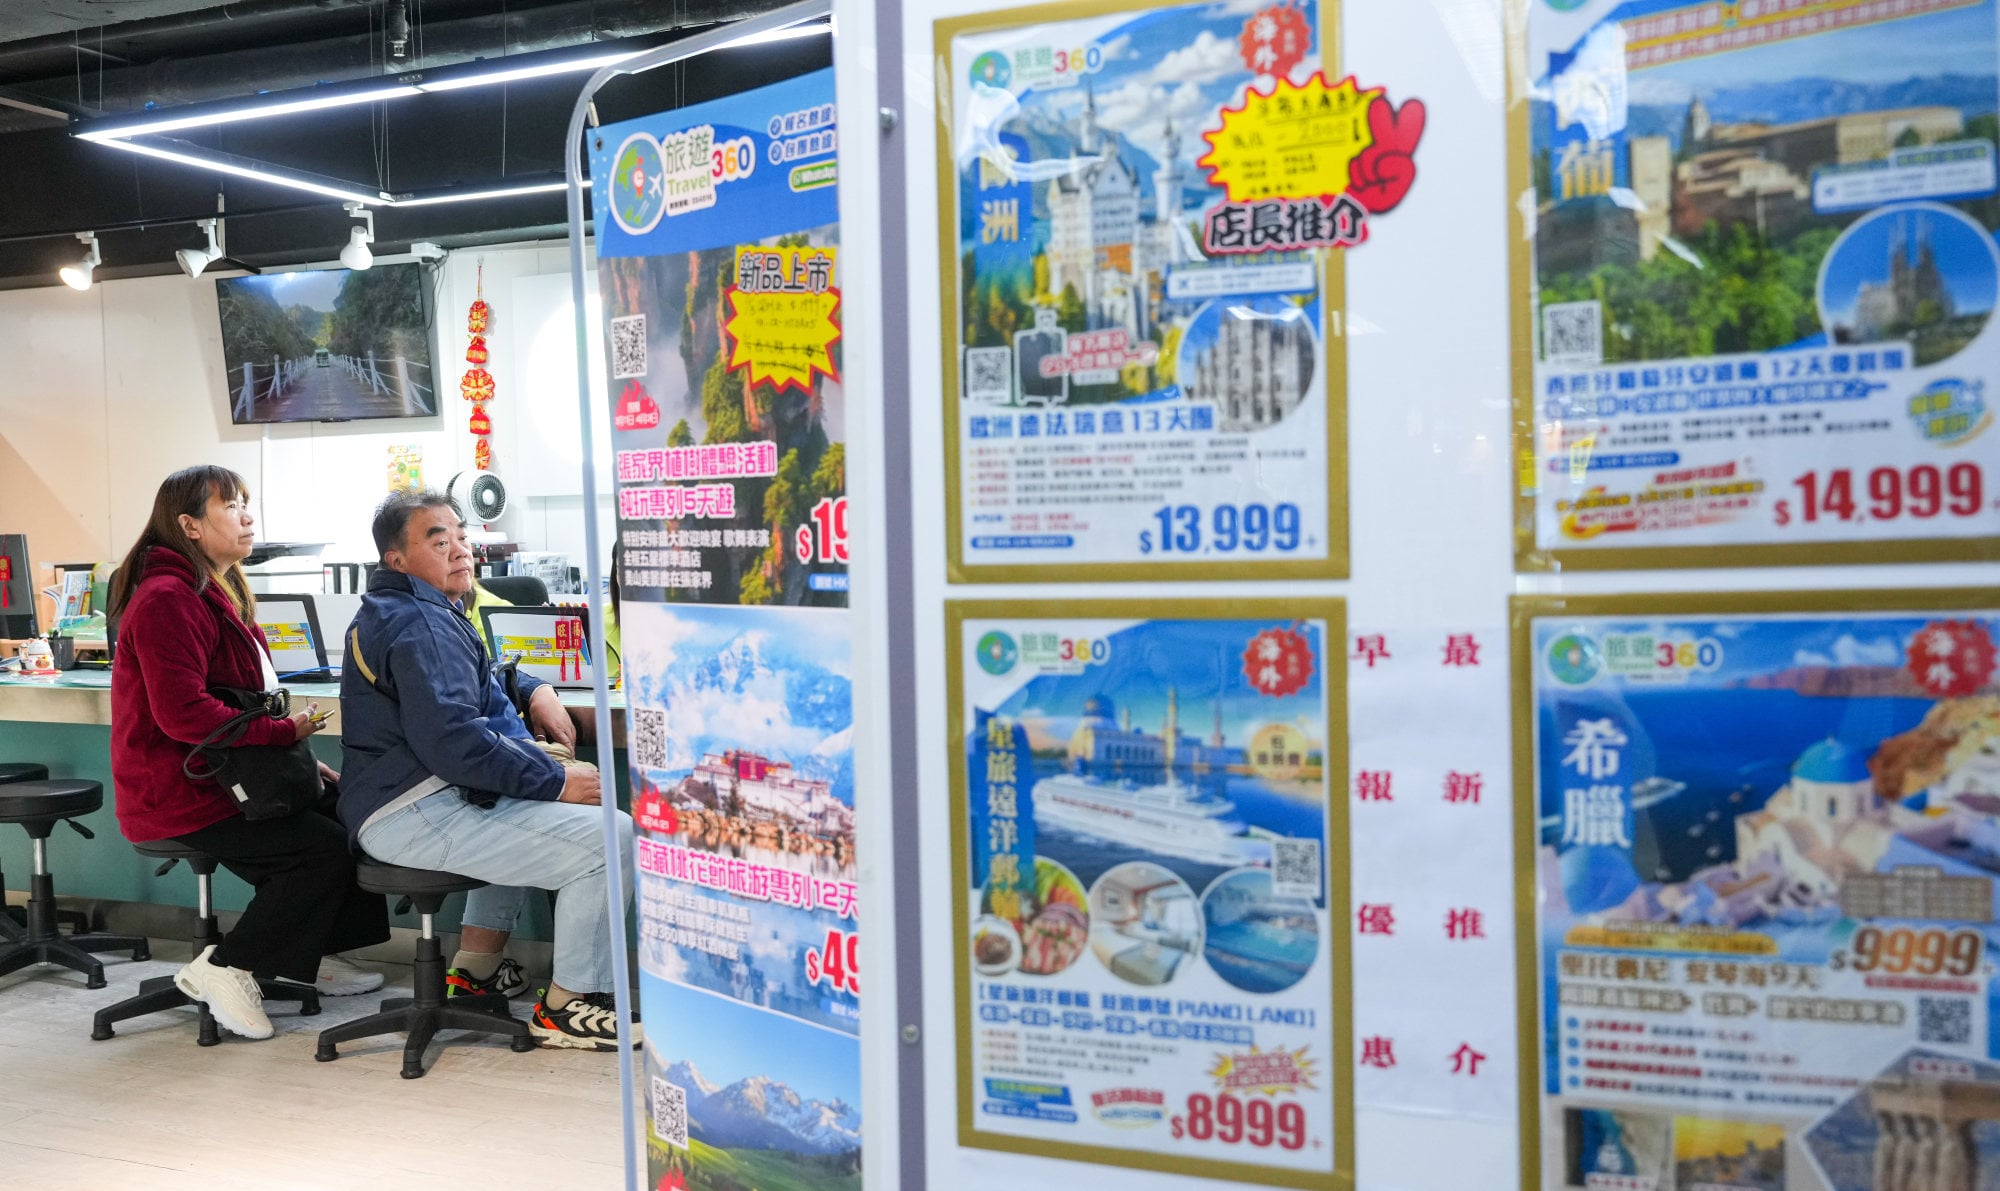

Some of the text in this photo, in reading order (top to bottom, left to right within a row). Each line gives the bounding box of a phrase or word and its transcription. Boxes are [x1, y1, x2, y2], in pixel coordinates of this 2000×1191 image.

[667, 171, 711, 197] Travel
[1211, 198, 1364, 248] 店長推介
[739, 252, 832, 292] 新品上市
[618, 443, 776, 480] 張家界植樹體驗活動
[619, 486, 734, 517] 純玩專列5天遊
[1773, 462, 1982, 527] $14,999
